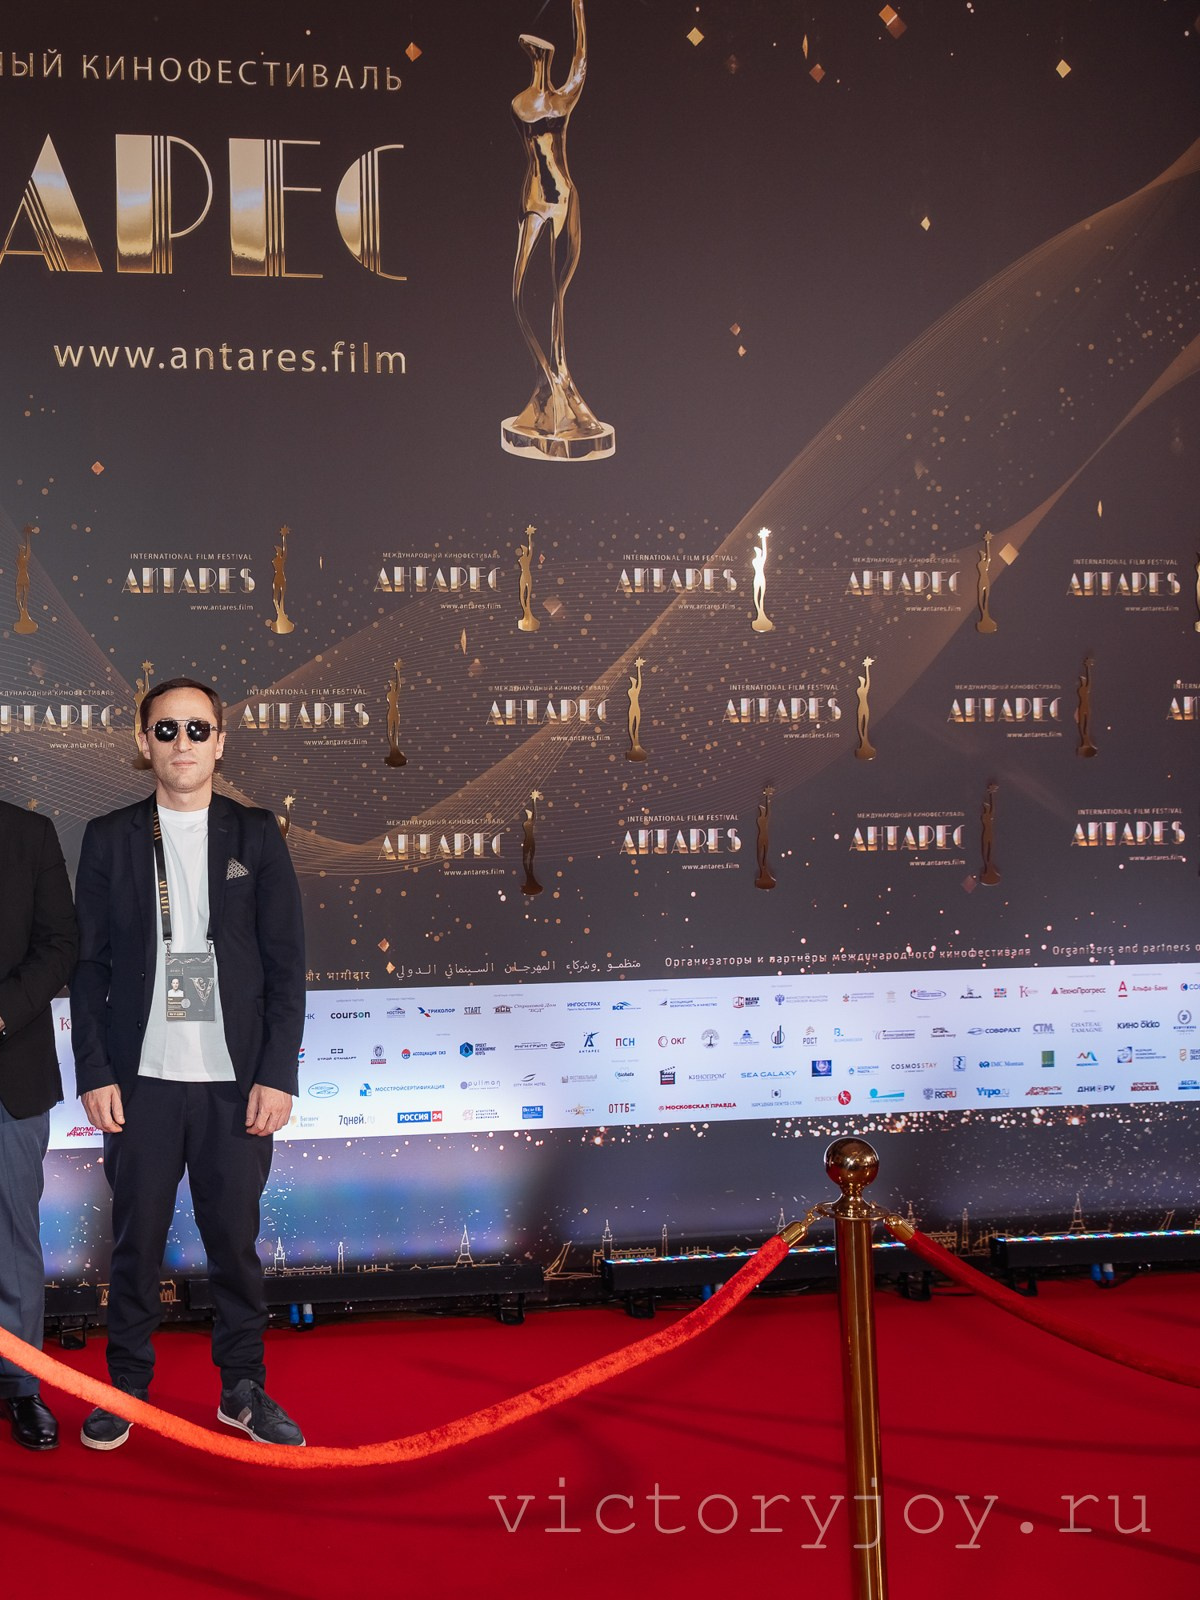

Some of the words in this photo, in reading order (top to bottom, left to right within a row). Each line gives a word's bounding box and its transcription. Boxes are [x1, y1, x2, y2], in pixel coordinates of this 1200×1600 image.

[81, 53, 404, 93] КИНОФЕСТИВАЛЬ
[52, 338, 408, 376] www.antares.film
[121, 566, 255, 594] ANTARES
[374, 566, 502, 593] АНТАРЕС
[616, 567, 737, 594] ANTARES
[844, 570, 961, 596] АНТАРЕС
[1066, 571, 1181, 596] ANTARES
[189, 604, 254, 612] www.antares.film
[238, 702, 370, 729] ANTARES
[486, 699, 610, 725] АНТАРЕС
[722, 697, 841, 723] ANTARES
[947, 697, 1062, 722] АНТАРЕС
[627, 814, 684, 822] INTERNATIONAL
[688, 814, 704, 822] FILM
[707, 814, 739, 822] FESTIVAL
[377, 832, 505, 860] АНТАРЕС
[619, 827, 742, 855] ANTARES
[849, 824, 966, 852] АНТАРЕС
[1071, 820, 1186, 847] ANTARES
[443, 868, 505, 876] www.antares.film
[682, 862, 740, 870] www.antares.film
[665, 956, 752, 969] Организаторы
[1052, 943, 1114, 958] Organizers
[1118, 943, 1138, 953] and
[1142, 942, 1190, 954] partners
[330, 1011, 370, 1020] courson
[1117, 1021, 1139, 1030] КИНО
[615, 1038, 635, 1047] ПСН
[670, 1037, 687, 1045] ОКГ
[740, 1071, 759, 1079] SEA
[760, 1070, 797, 1078] GALAXY
[399, 1113, 430, 1121] РОССИЯ
[432, 1111, 442, 1119] 24
[608, 1102, 630, 1114] ОТТБ
[665, 1103, 709, 1111] МОСКОВСКАЯ
